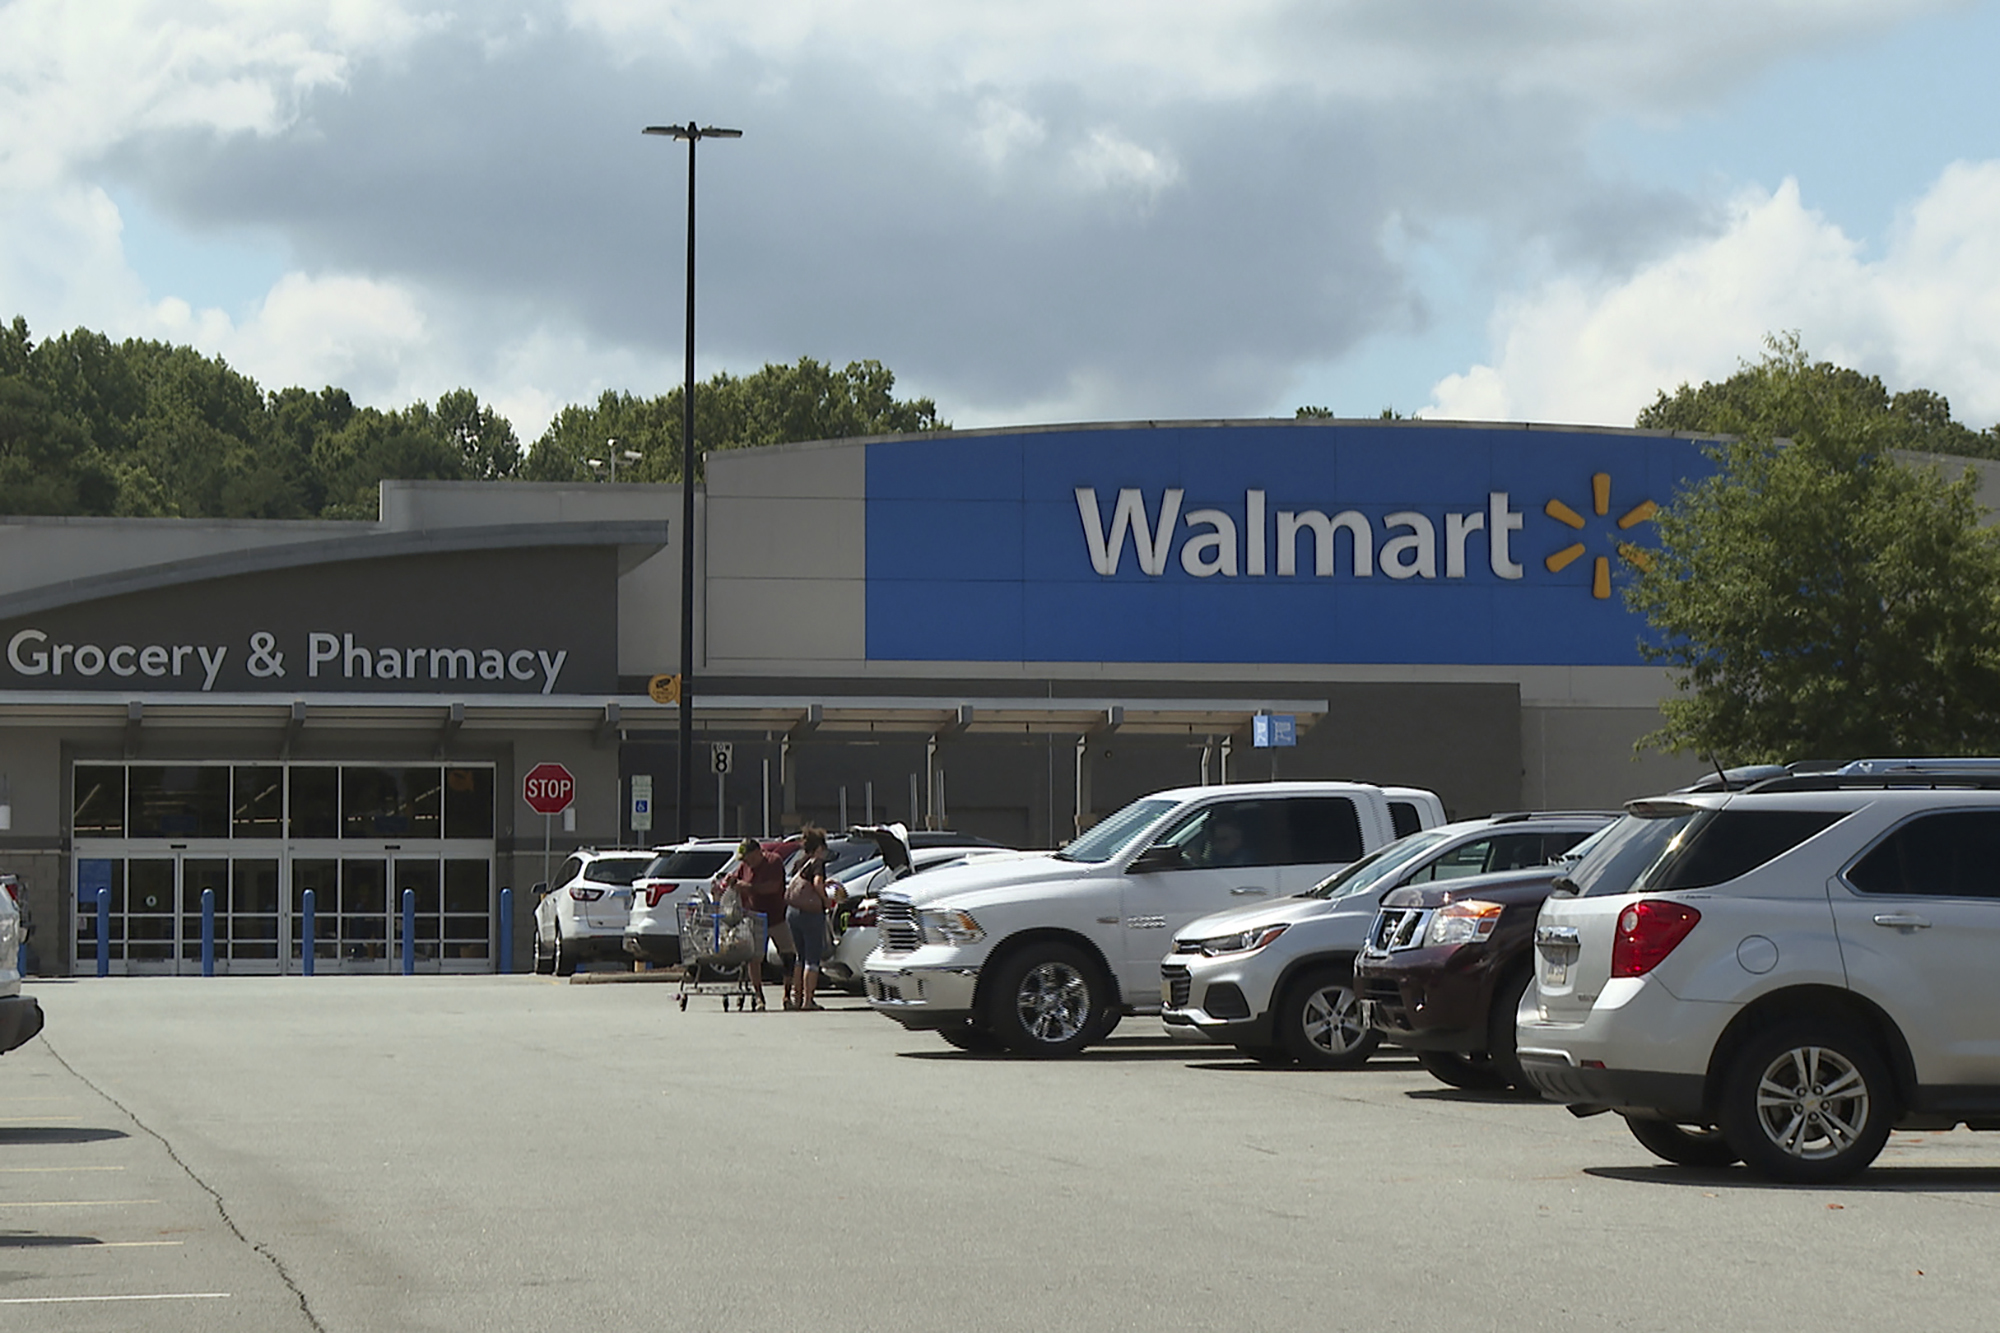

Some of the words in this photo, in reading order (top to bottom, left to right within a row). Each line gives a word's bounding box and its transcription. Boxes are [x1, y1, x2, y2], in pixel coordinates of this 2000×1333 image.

[1074, 487, 1524, 579] Walmart
[7, 630, 227, 691] Grocery
[247, 632, 286, 678] &
[308, 632, 567, 695] Pharmacy
[716, 751, 728, 772] 8
[527, 778, 571, 798] STOP
